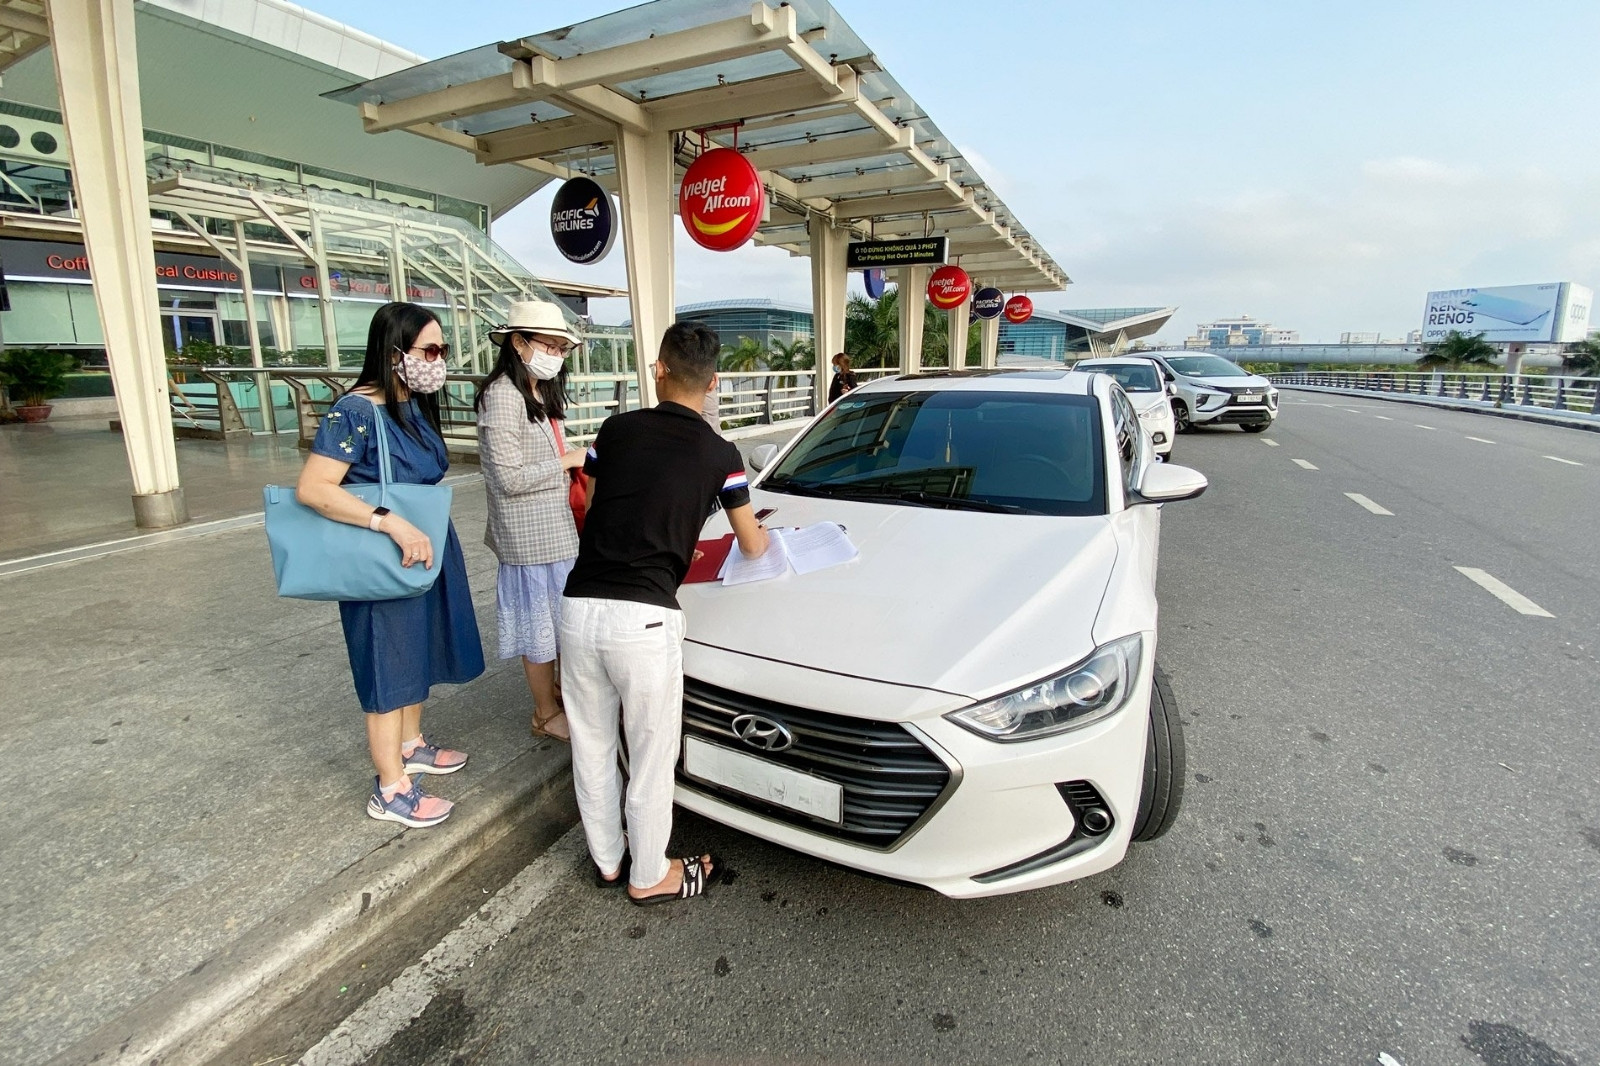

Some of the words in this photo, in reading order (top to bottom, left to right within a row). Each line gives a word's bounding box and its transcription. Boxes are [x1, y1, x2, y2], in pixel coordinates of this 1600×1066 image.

[685, 176, 727, 200] Vietjet
[703, 194, 750, 213] Air.com
[553, 208, 583, 222] PACIFIC
[553, 219, 593, 232] AIRLINES
[183, 265, 238, 281] Cuisine
[1428, 311, 1475, 325] RENO5
[1427, 329, 1447, 337] OPPO
